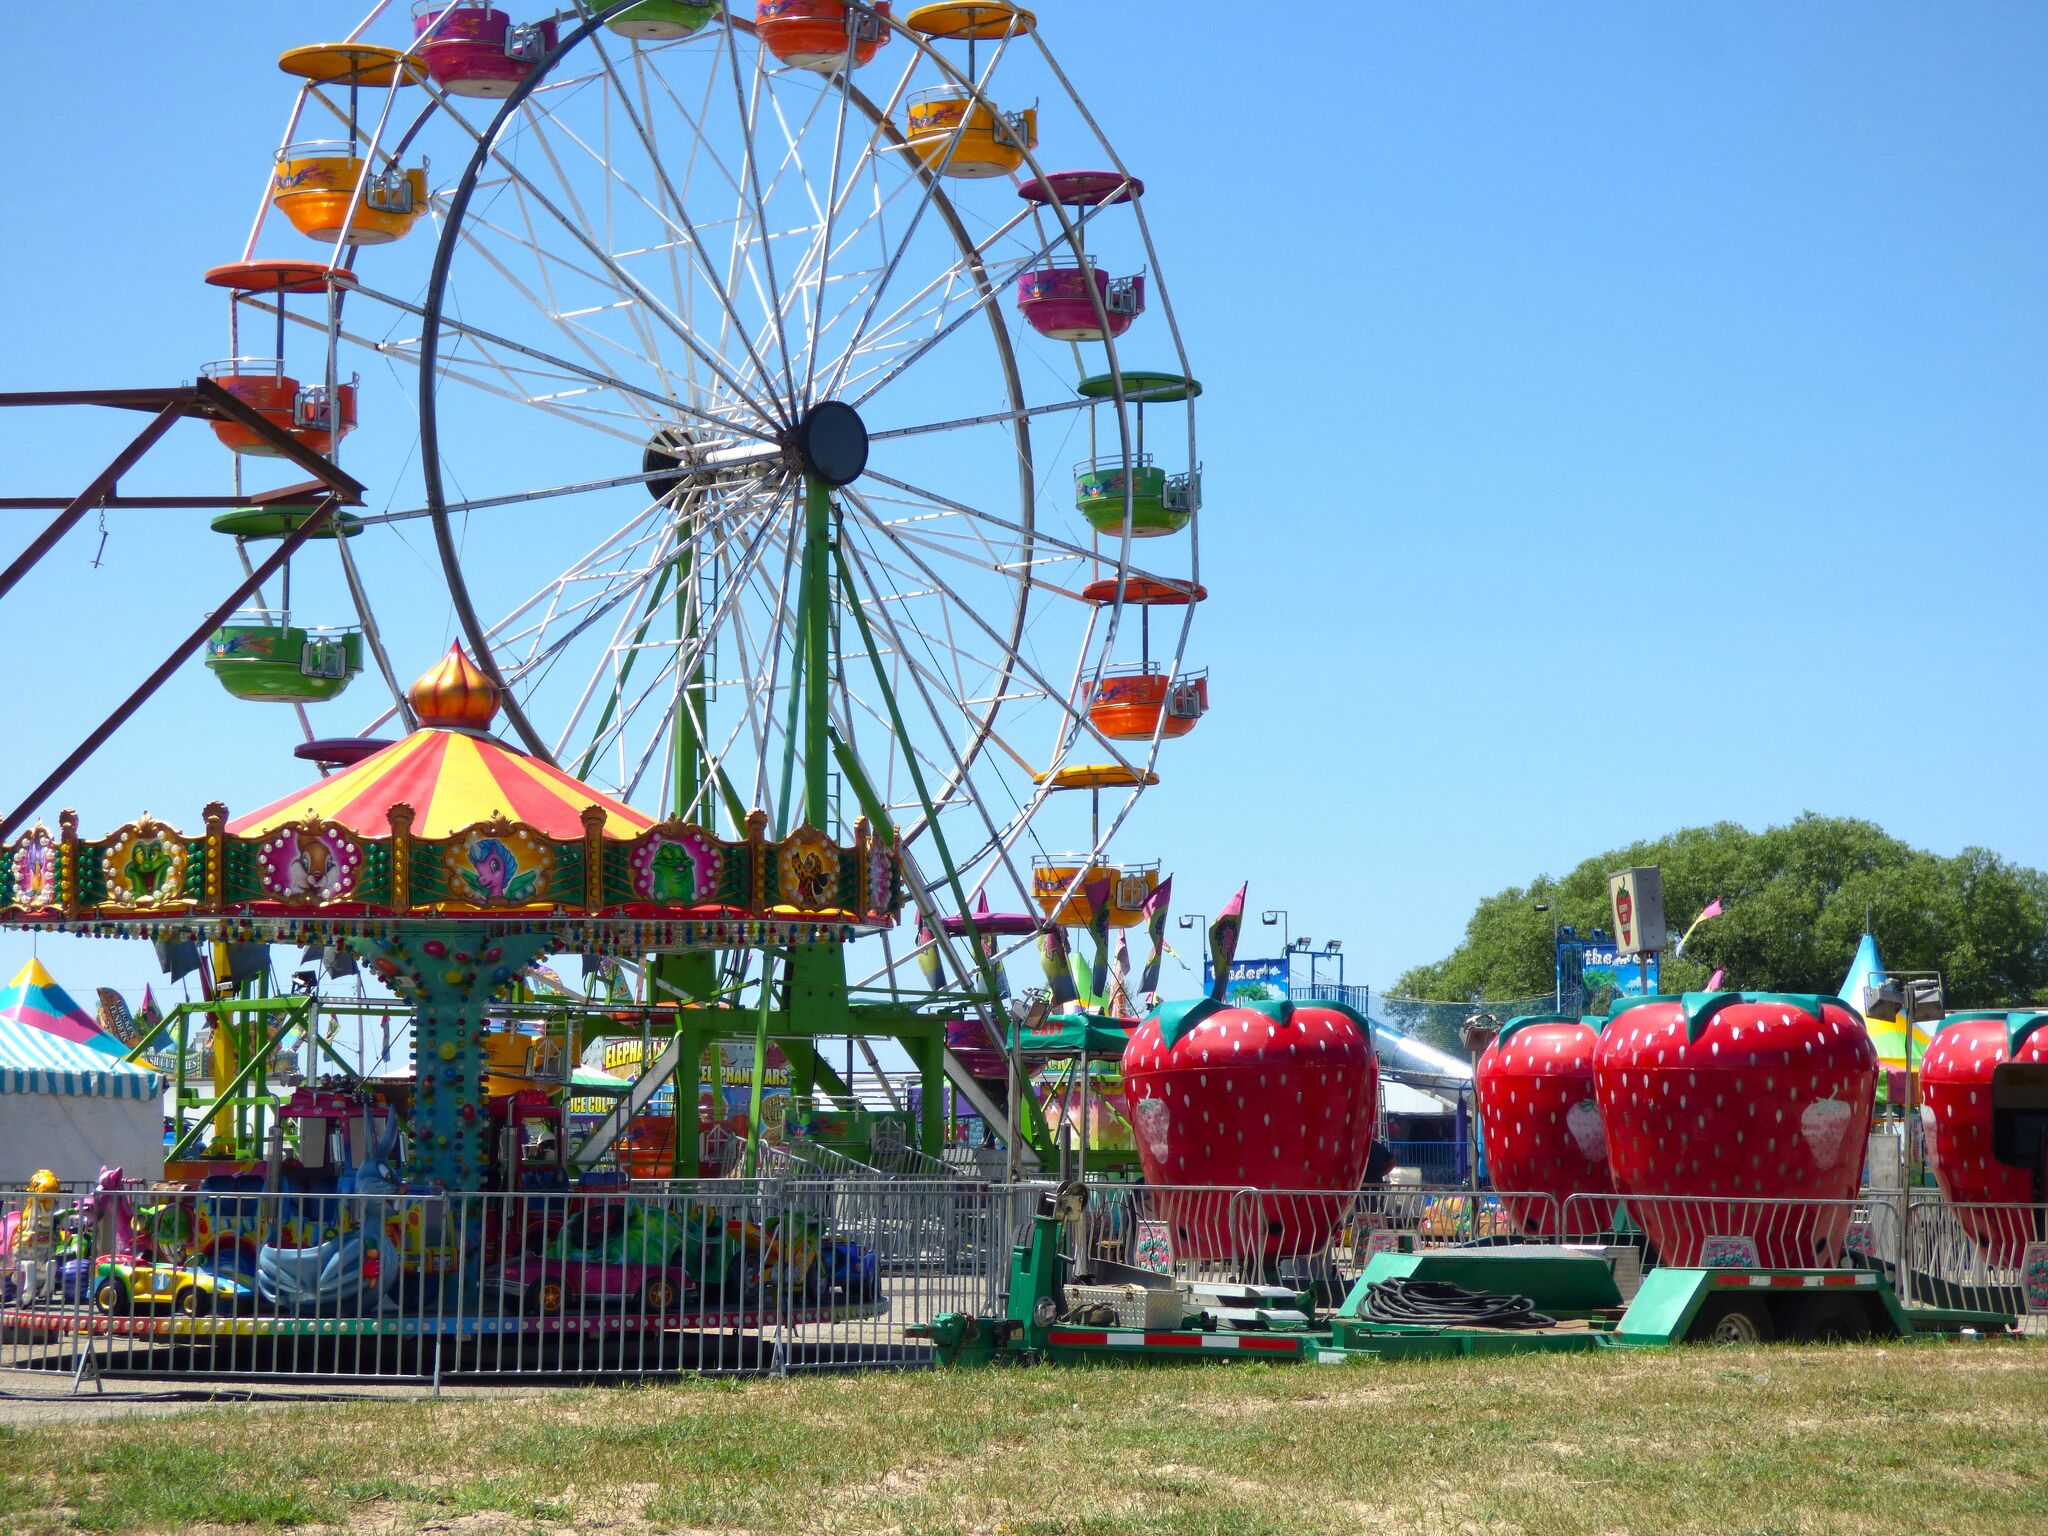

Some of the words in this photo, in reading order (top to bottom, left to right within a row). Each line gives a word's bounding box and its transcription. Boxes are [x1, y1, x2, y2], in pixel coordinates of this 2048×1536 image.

[1585, 948, 1613, 966] the
[110, 1004, 128, 1043] TENDERS
[160, 1056, 175, 1069] CUT
[605, 1040, 658, 1069] ELEPHA
[701, 1065, 754, 1086] ELPHANT
[762, 1068, 789, 1086] ARS
[569, 1096, 586, 1113] ICE
